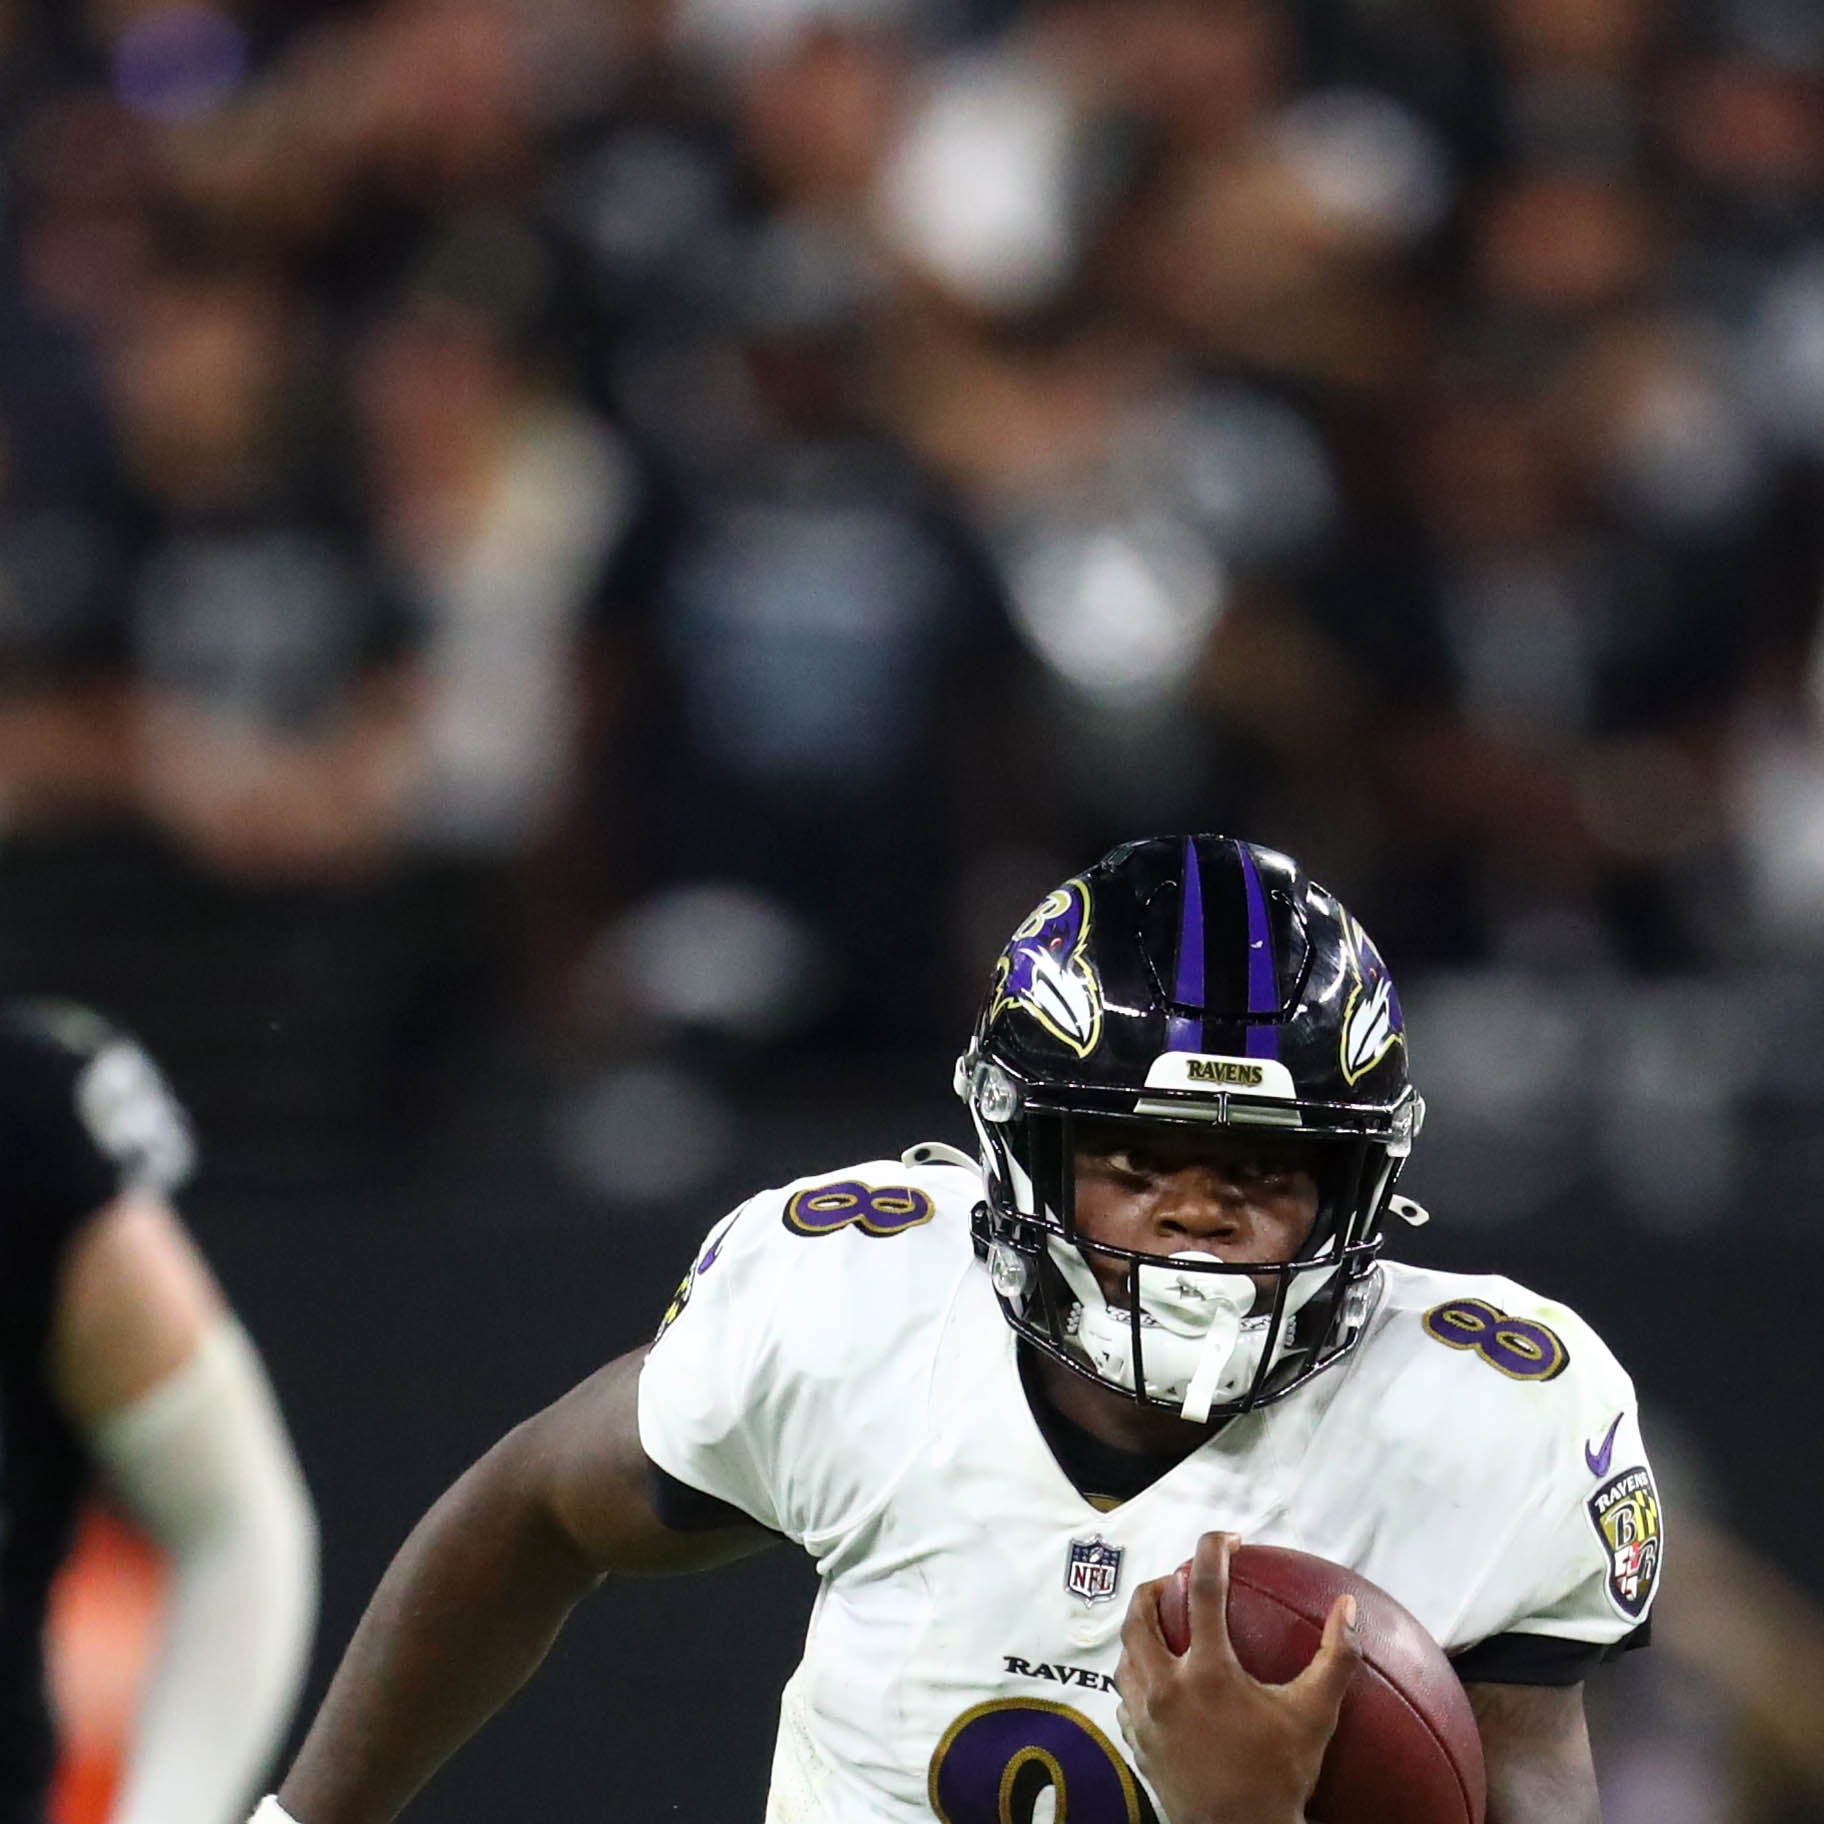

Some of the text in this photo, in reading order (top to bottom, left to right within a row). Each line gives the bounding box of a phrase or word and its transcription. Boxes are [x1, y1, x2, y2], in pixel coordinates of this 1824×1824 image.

[1185, 1060, 1264, 1088] RAVENS
[782, 1178, 936, 1239] 8
[1421, 1297, 1570, 1381] 8
[1594, 1471, 1650, 1515] RAVENS
[1072, 1564, 1112, 1592] NFL
[1002, 1655, 1125, 1702] RAVEN
